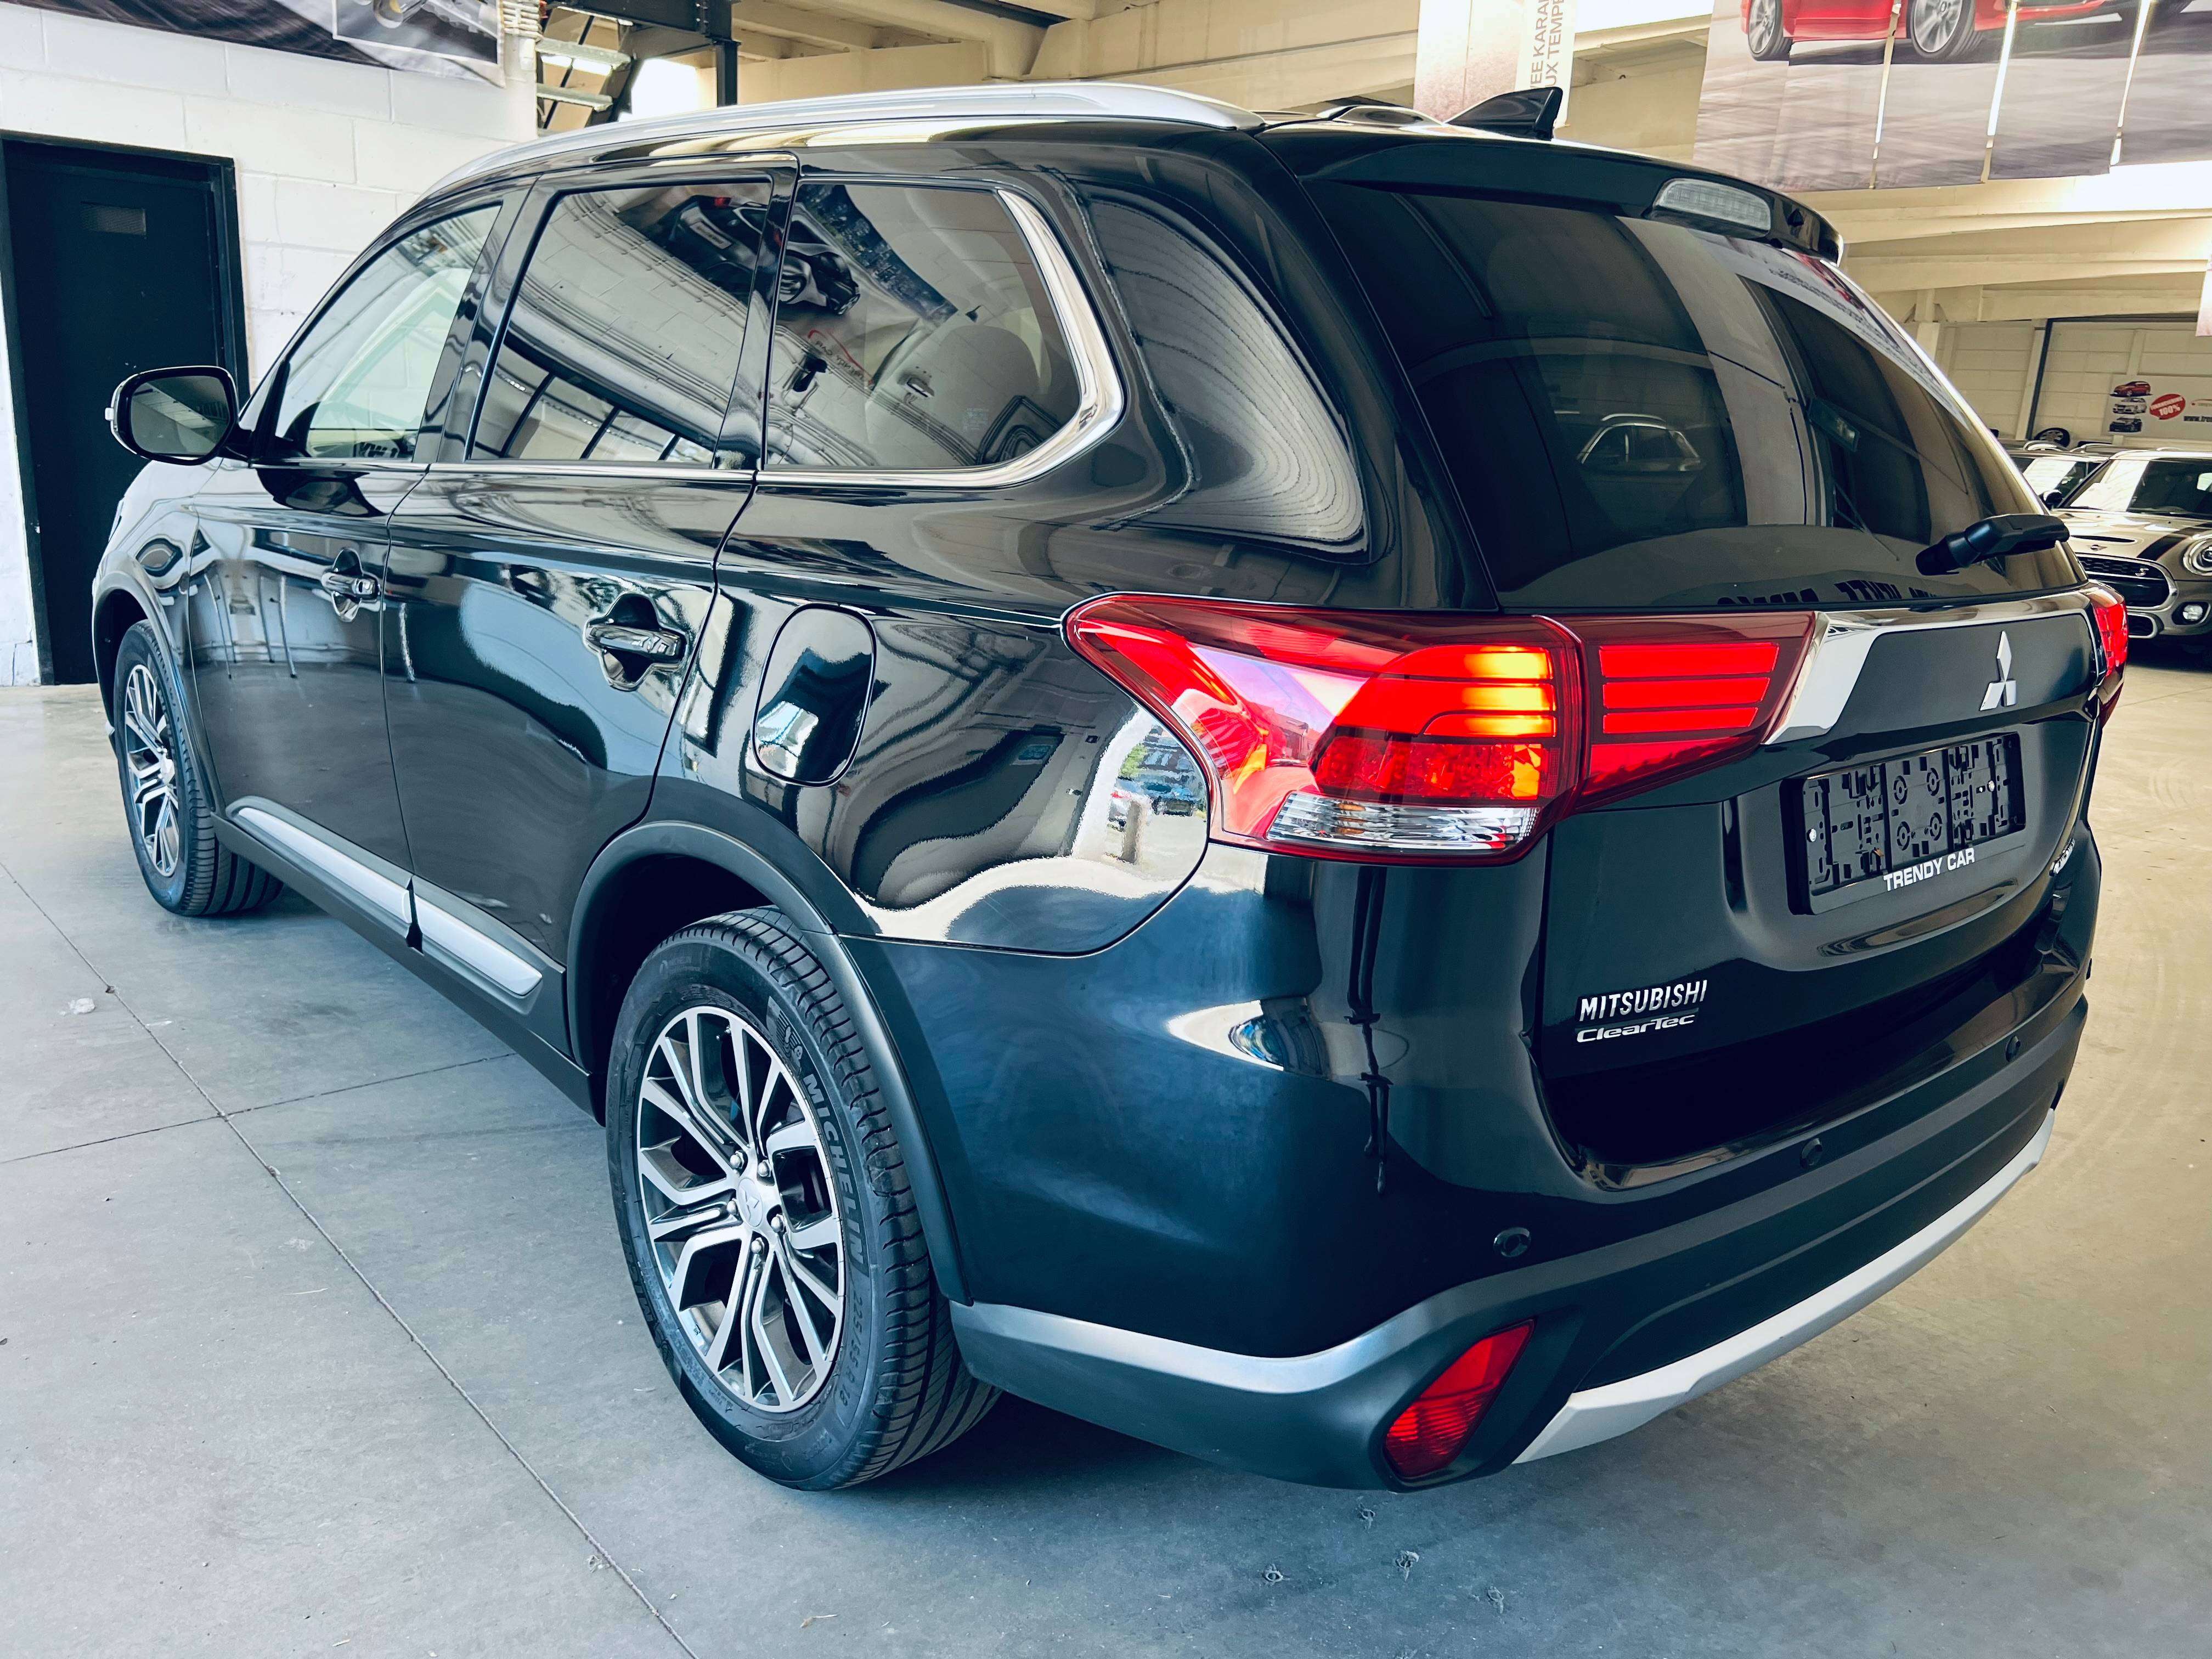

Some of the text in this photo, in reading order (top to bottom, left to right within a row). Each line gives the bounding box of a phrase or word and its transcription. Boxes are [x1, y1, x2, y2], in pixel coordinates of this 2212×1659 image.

[1533, 0, 1549, 58] KARA
[2159, 404, 2181, 416] 100%
[1883, 848, 1975, 891] TRENDY CAR
[1579, 979, 1707, 1022] MITSUBISHI
[1577, 1014, 1695, 1042] ClearTec
[803, 1073, 865, 1266] MICHELIN
[850, 1290, 864, 1368] 225/55
[839, 1384, 851, 1407] 18
